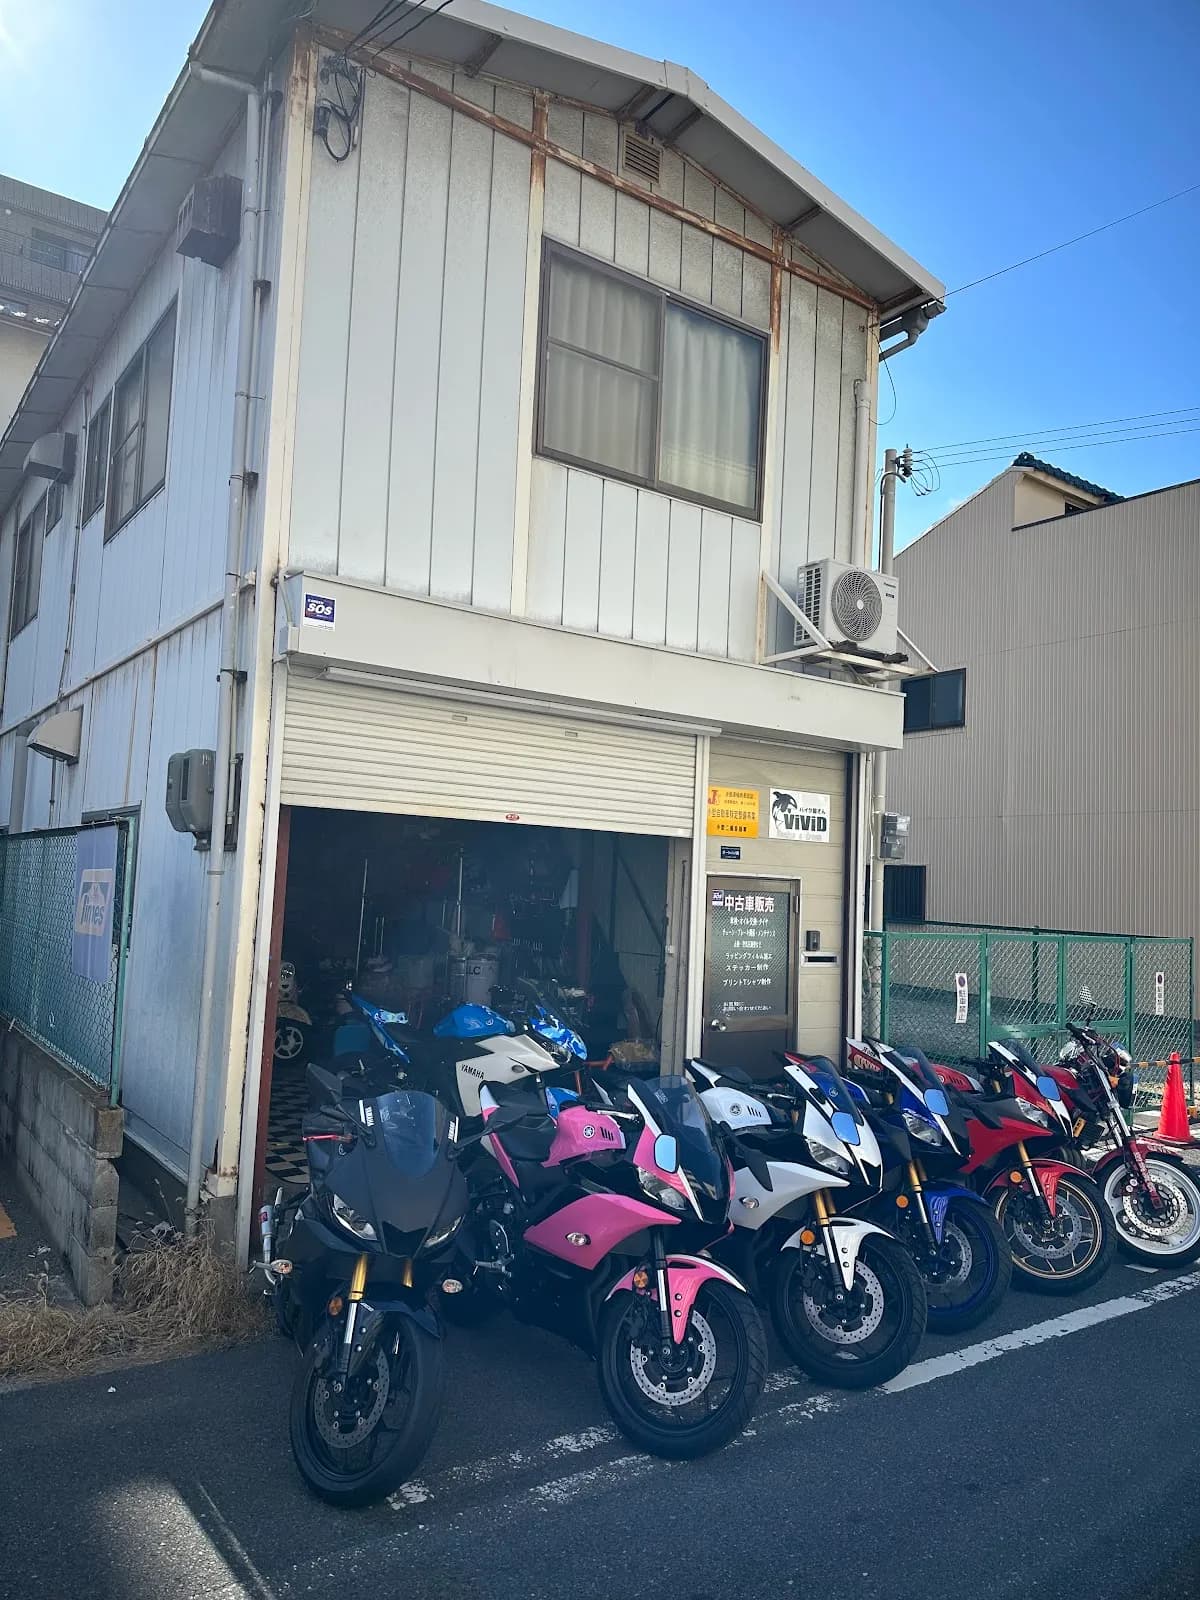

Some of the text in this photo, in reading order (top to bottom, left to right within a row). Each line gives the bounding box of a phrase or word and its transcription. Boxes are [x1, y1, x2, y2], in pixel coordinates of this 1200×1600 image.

[307, 603, 333, 616] SOS
[724, 894, 775, 913] 中古車販売
[460, 1064, 485, 1080] YAMAHA
